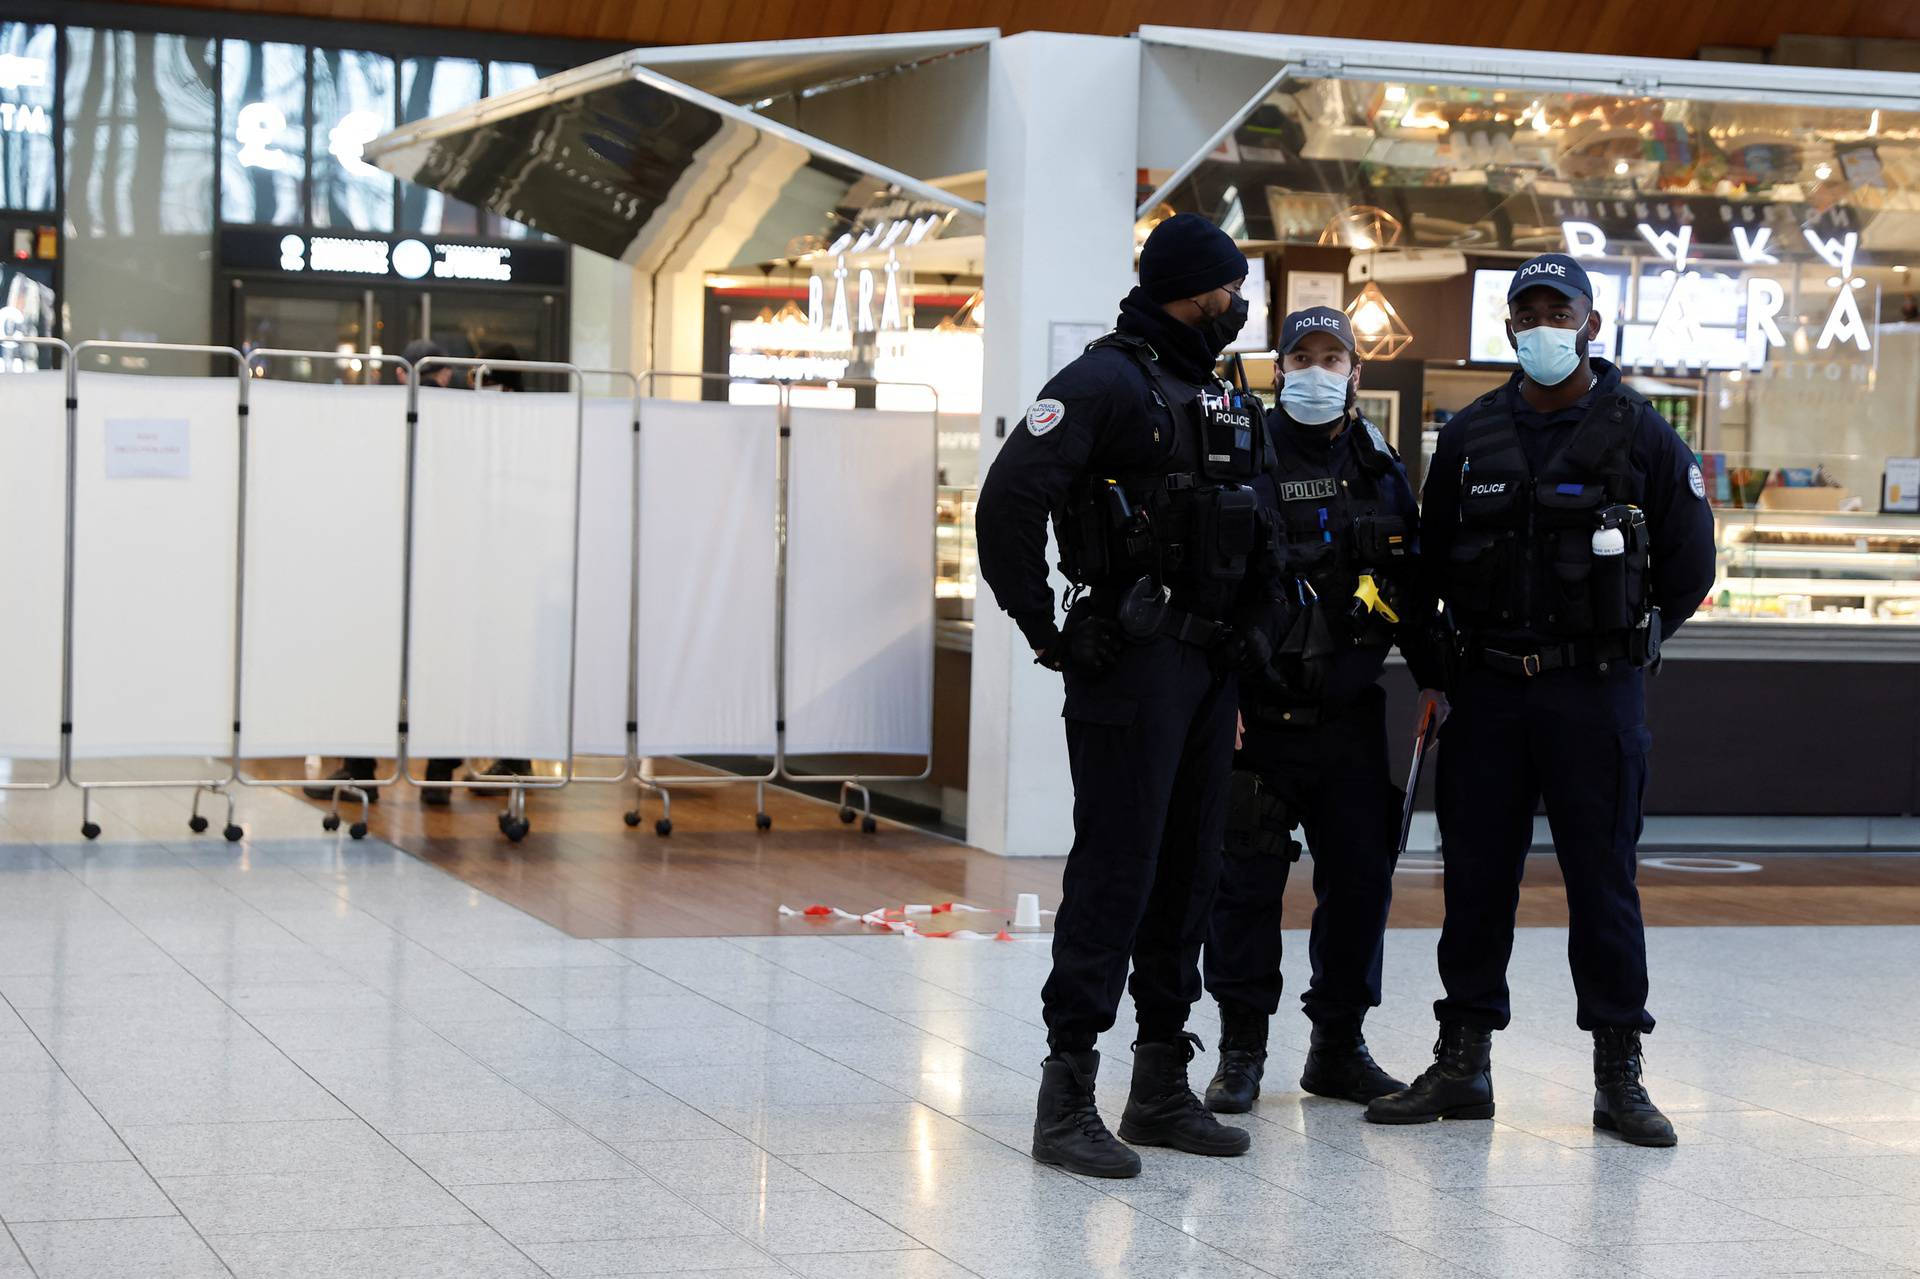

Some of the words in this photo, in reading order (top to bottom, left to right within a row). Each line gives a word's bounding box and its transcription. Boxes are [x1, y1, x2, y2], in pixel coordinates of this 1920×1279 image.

[1520, 262, 1566, 280] POLICE
[808, 255, 901, 332] BARA
[1295, 315, 1340, 331] POLICE
[1215, 412, 1250, 428] POLICE
[1285, 480, 1335, 499] POLICE
[1470, 482, 1506, 496] POLICE
